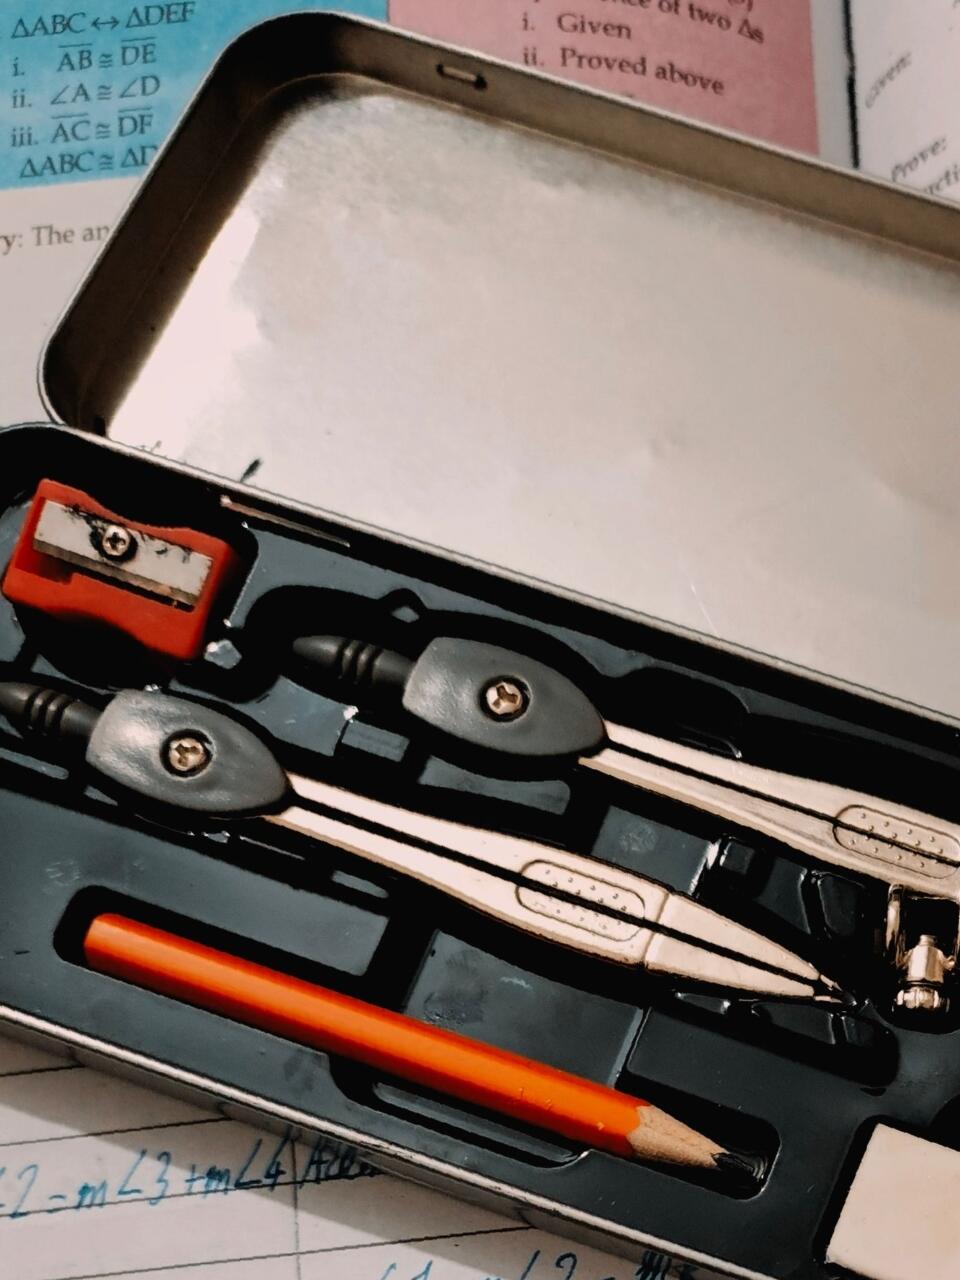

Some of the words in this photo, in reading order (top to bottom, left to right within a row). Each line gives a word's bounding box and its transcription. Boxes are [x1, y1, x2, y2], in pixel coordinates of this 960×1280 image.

[557, 13, 632, 40] Given
[688, 4, 730, 31] two
[560, 48, 646, 77] Proved
[655, 64, 725, 96] above
[32, 225, 75, 248] The
